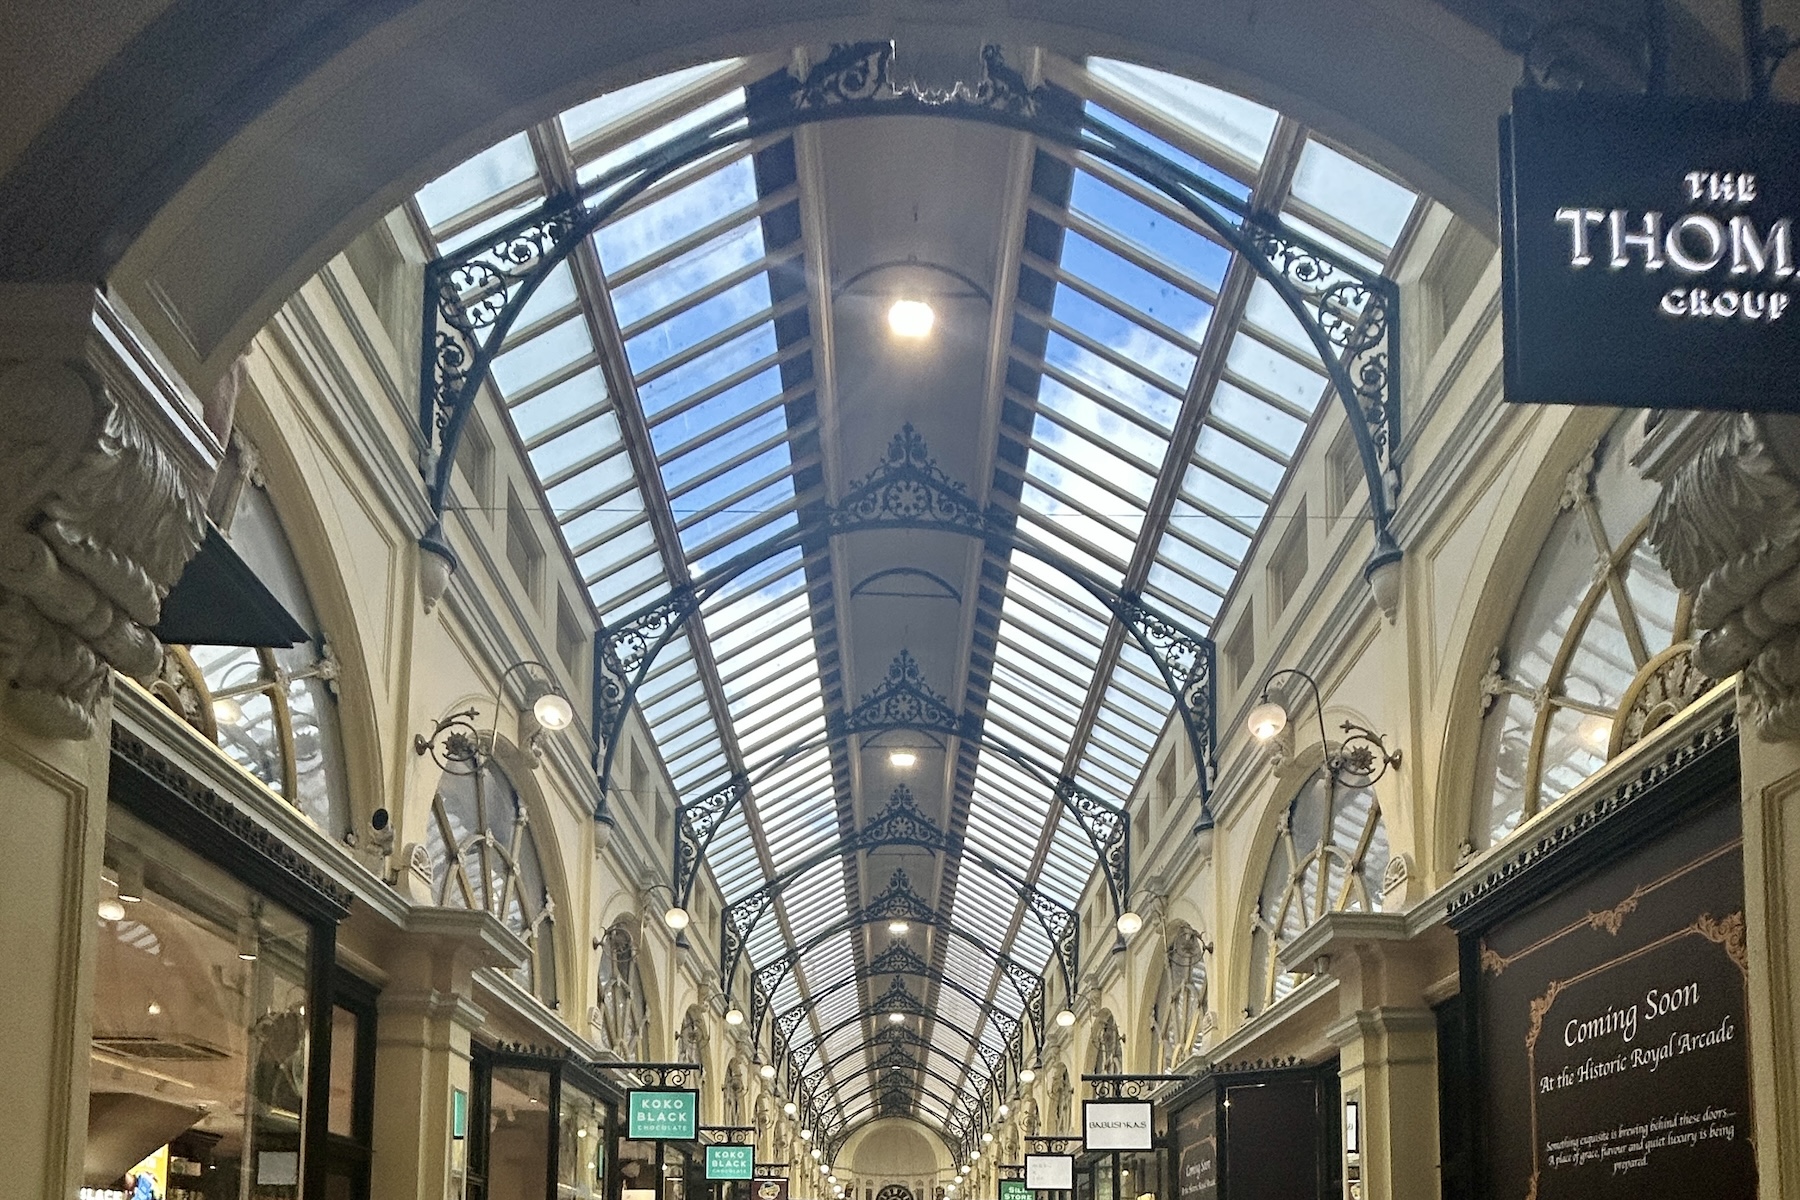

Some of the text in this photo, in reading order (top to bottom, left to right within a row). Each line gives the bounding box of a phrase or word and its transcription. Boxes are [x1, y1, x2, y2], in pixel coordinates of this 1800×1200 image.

[1685, 170, 1757, 202] THE
[1555, 207, 1800, 277] THOM
[1660, 287, 1790, 320] GROUP
[1564, 982, 1700, 1047] Coming Soon
[1540, 1015, 1735, 1094] At the Historic Royal Arcade
[637, 1112, 687, 1122] BLACK
[642, 1099, 683, 1109] KOKO
[1611, 1129, 1617, 1140] is
[1619, 1123, 1648, 1139] brewing
[1650, 1117, 1679, 1132] behind
[1680, 1111, 1700, 1126] these
[715, 1151, 744, 1159] KOKO
[1548, 1155, 1555, 1166] A
[1573, 1148, 1580, 1166] of
[1628, 1139, 1643, 1152] and
[1645, 1136, 1666, 1153] quiet
[1668, 1131, 1697, 1147] luxury
[1699, 1128, 1707, 1140] is
[1709, 1122, 1735, 1140] being
[1004, 1193, 1033, 1200] STORE
